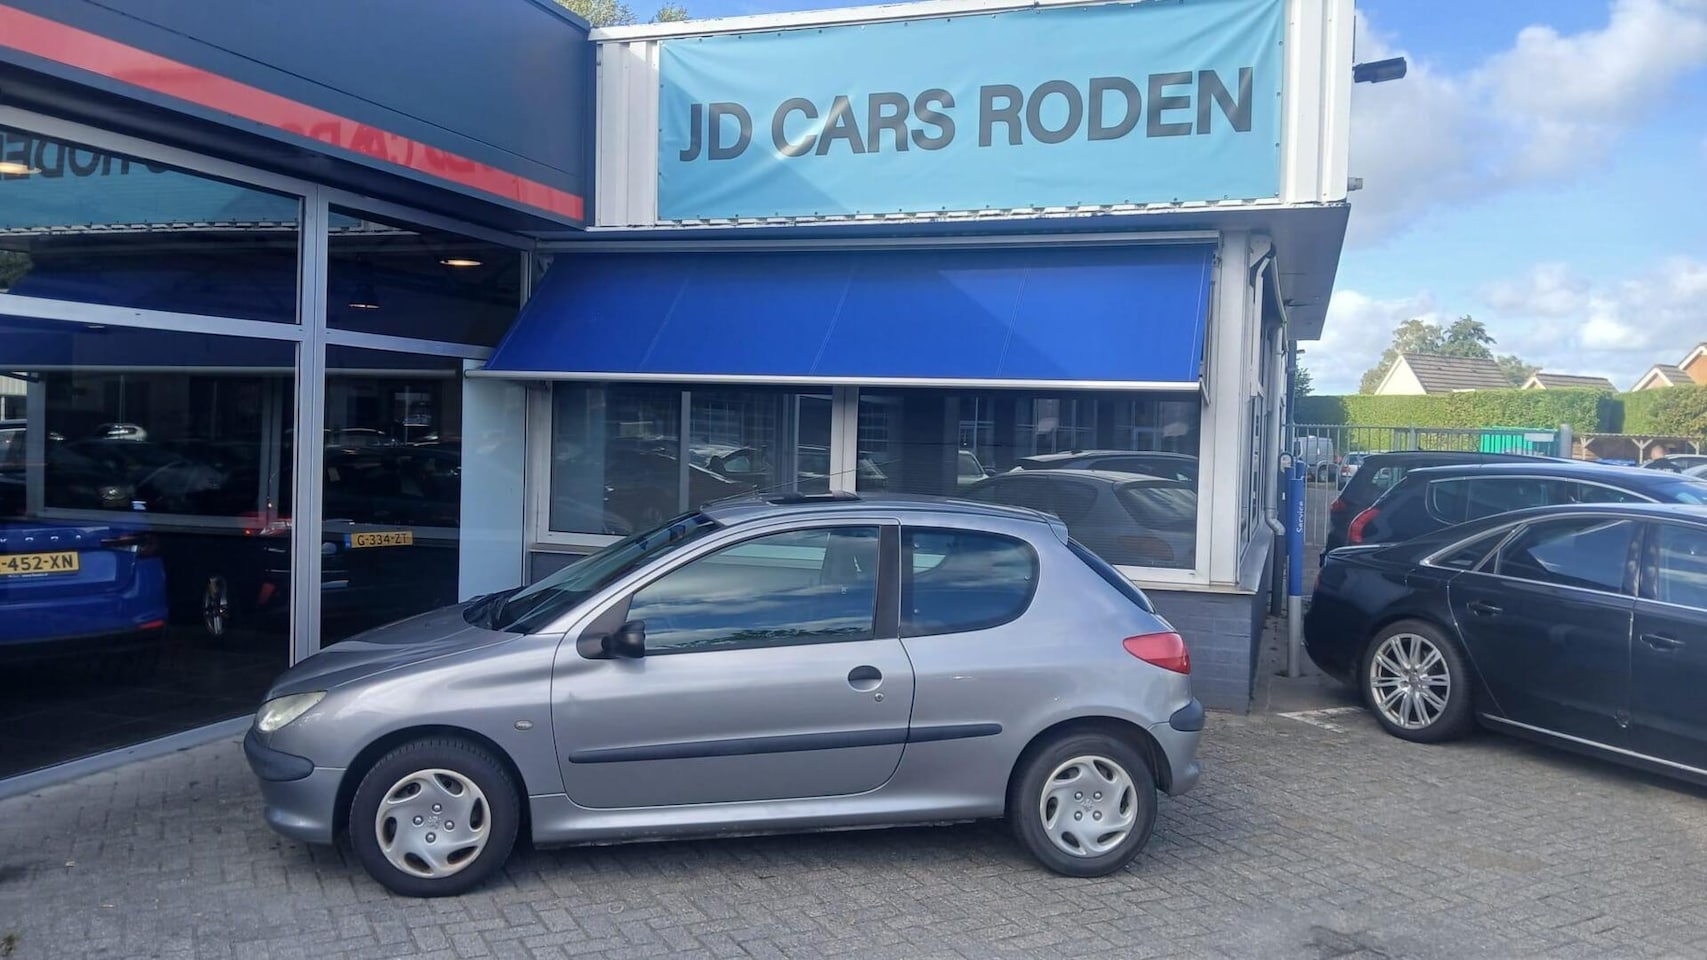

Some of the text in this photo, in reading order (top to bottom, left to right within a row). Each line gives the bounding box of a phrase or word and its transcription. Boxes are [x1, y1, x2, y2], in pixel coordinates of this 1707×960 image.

[680, 67, 1253, 162] JD CARS RODEN
[1296, 501, 1304, 533] Service
[357, 533, 407, 546] G-334-ZT
[0, 554, 74, 572] -452-XN
